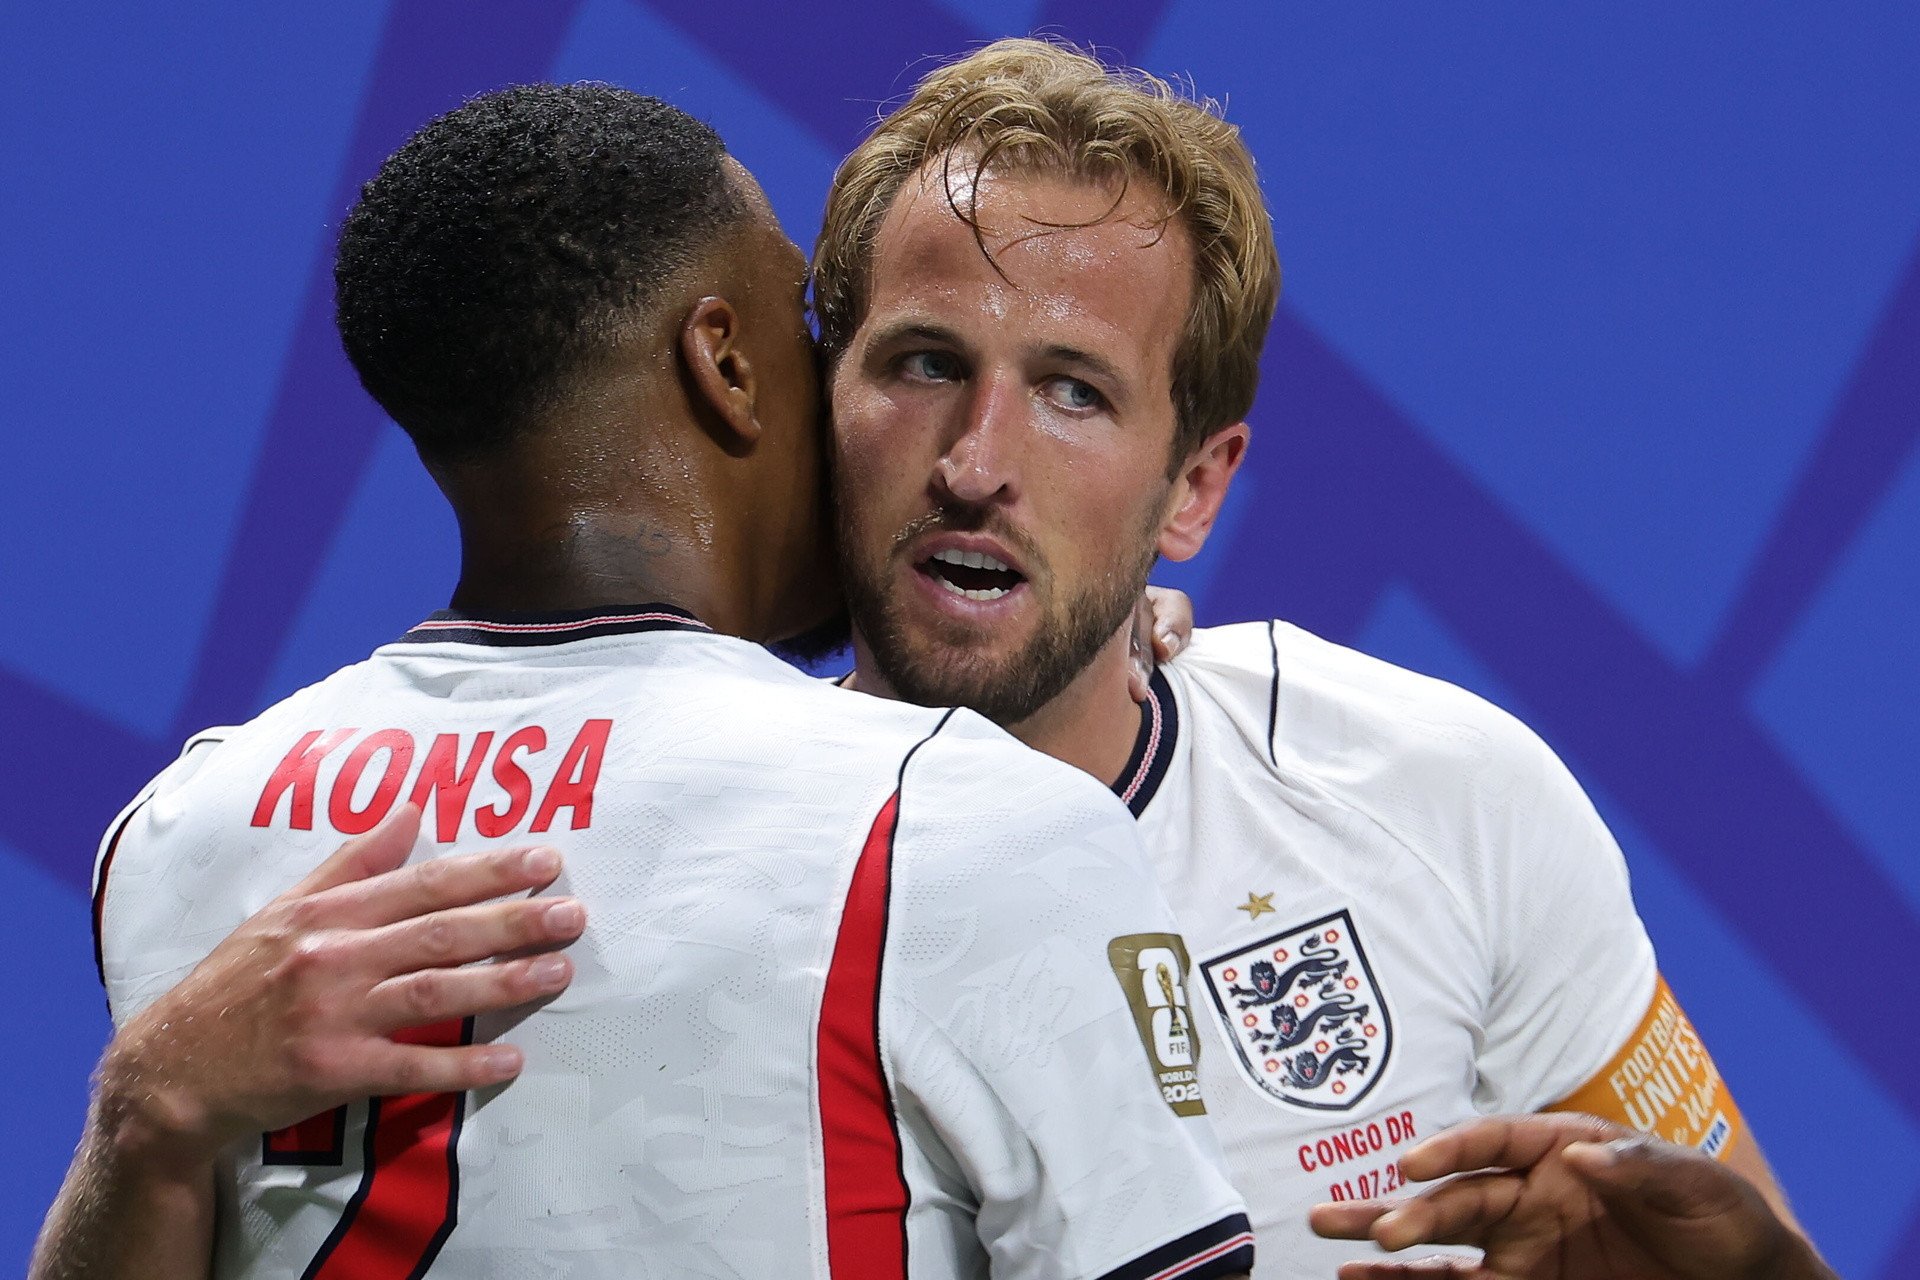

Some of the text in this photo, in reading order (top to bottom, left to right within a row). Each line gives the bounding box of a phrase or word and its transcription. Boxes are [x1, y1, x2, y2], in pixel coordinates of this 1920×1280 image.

[250, 719, 613, 843] KONSA
[1624, 1015, 1703, 1132] UNITES
[1298, 1111, 1416, 1172] CONGO DR
